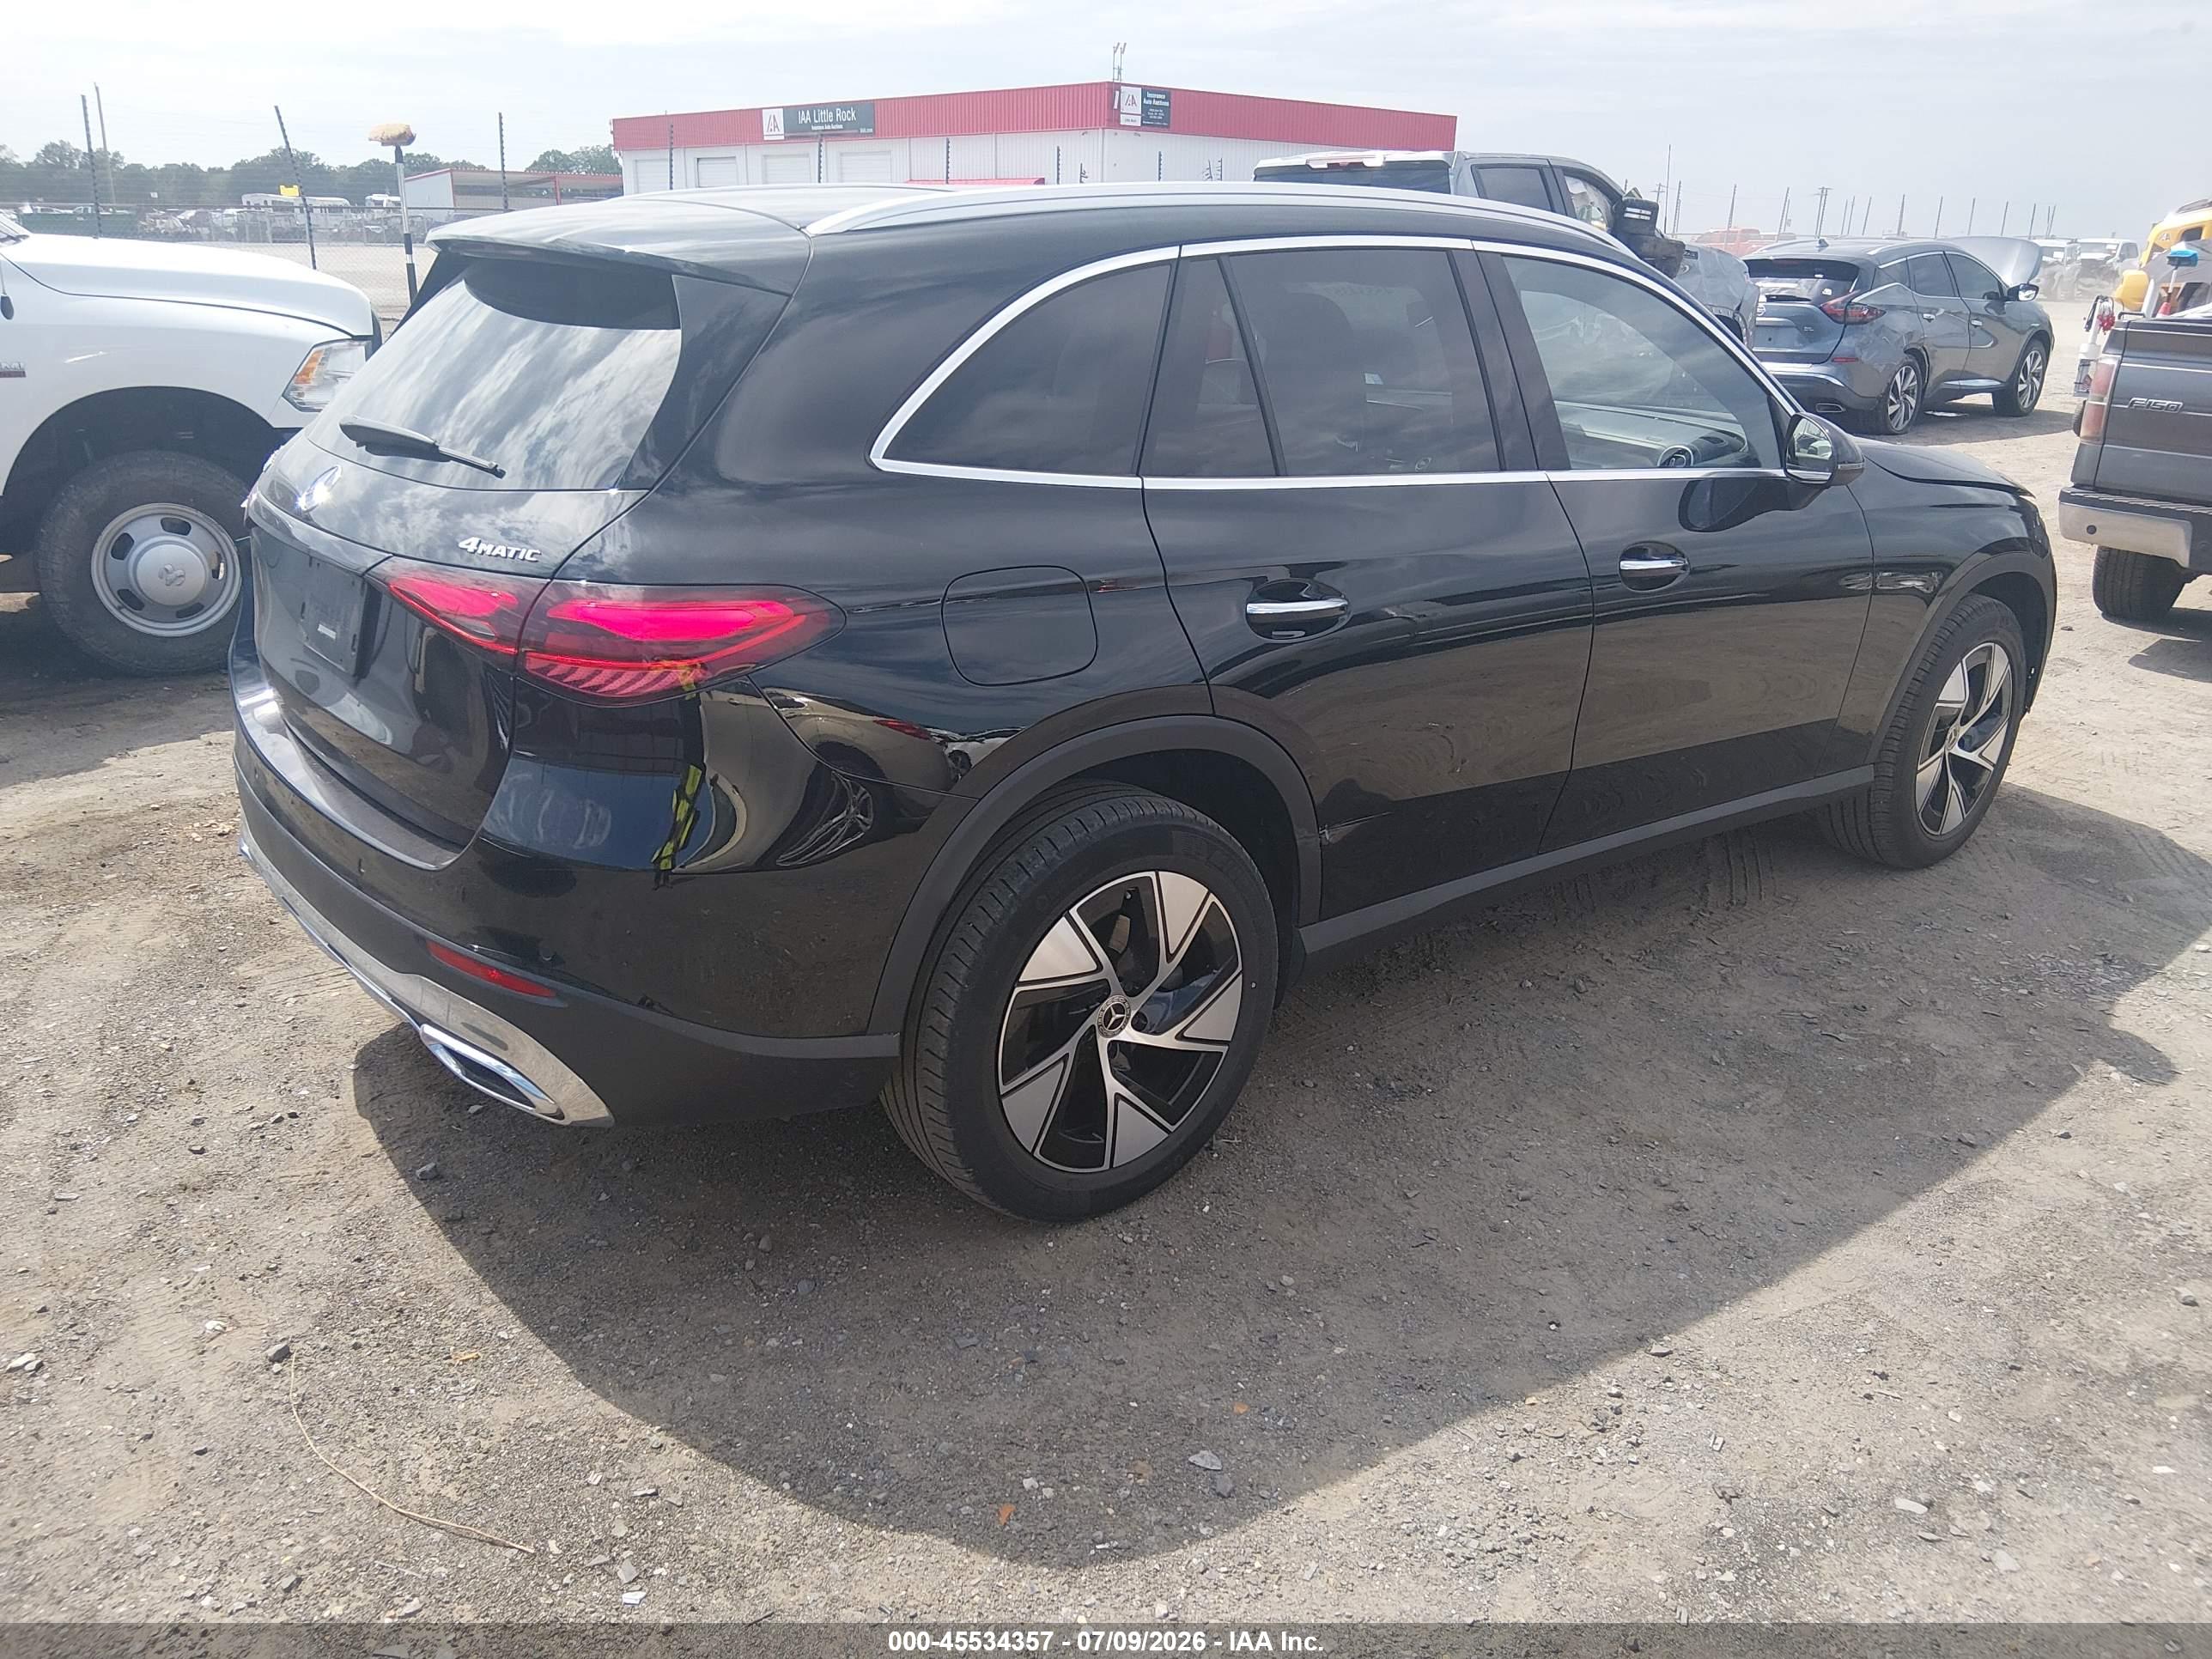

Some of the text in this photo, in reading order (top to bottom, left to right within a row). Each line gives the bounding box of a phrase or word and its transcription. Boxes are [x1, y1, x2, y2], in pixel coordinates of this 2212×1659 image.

[798, 107, 856, 125] IAA Little Rock
[458, 537, 542, 562] 4MATIC
